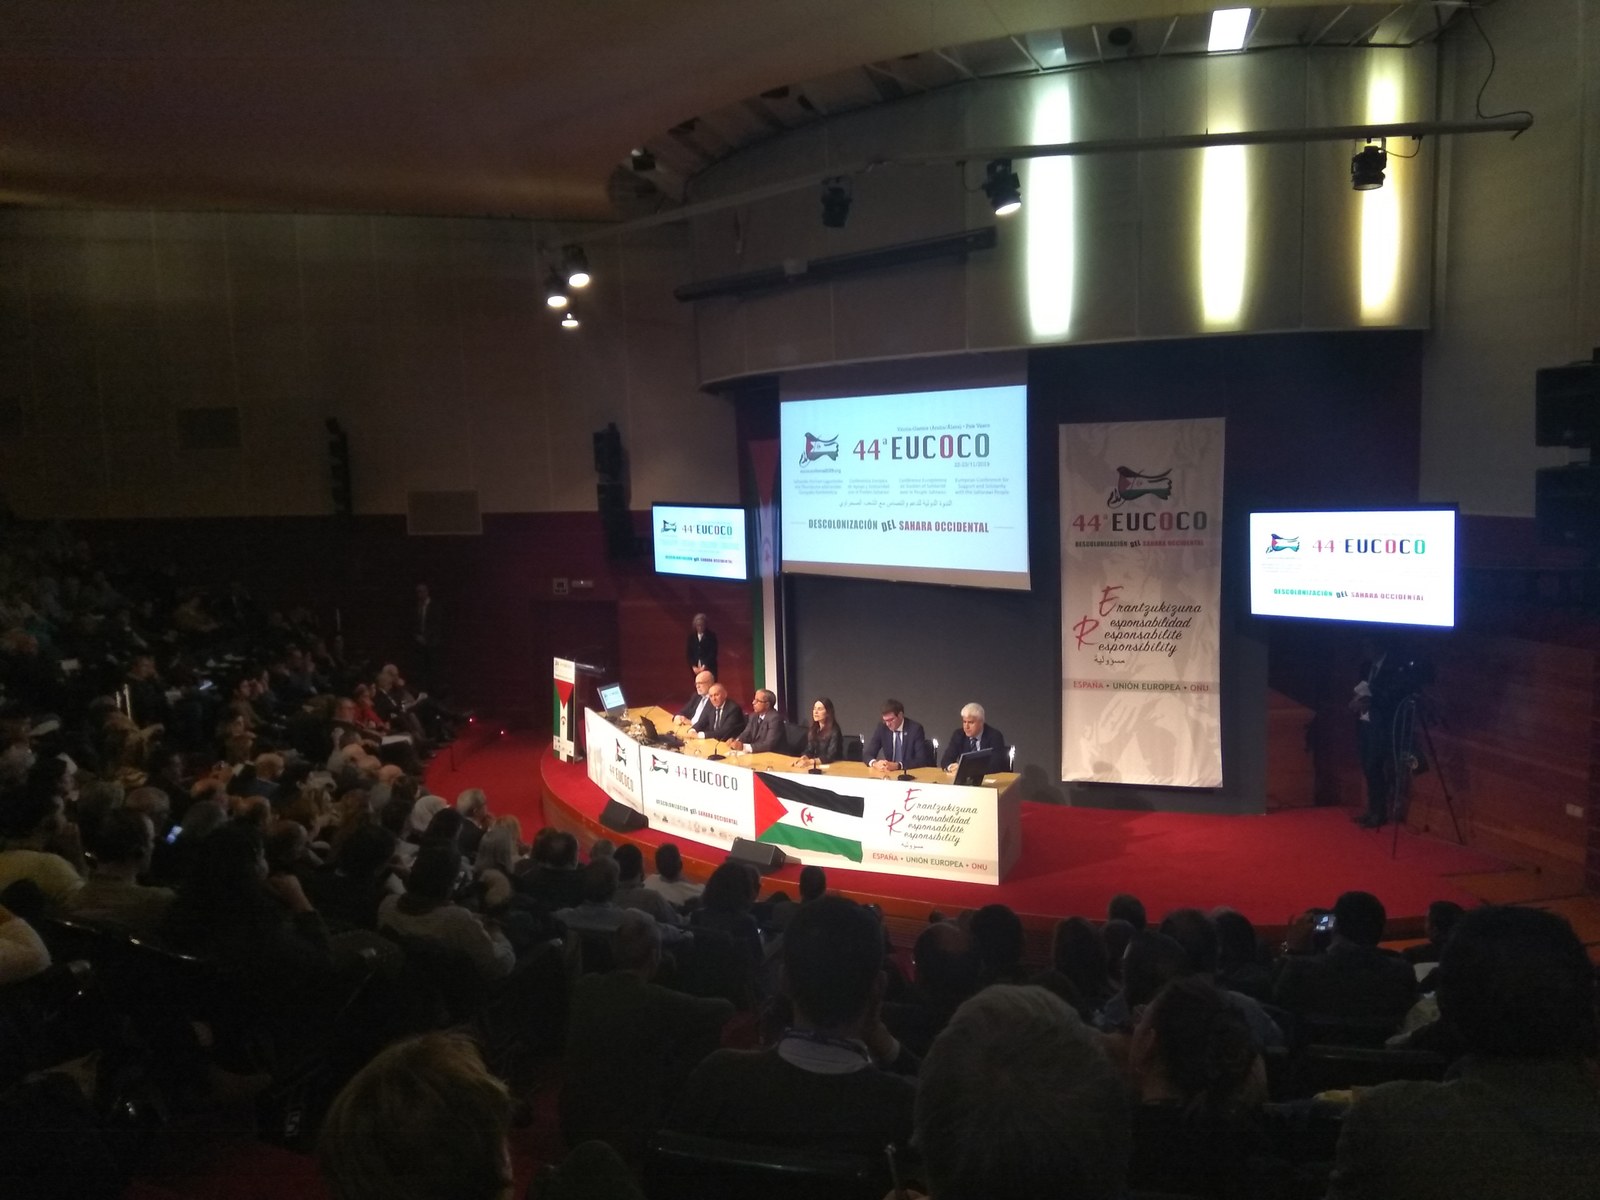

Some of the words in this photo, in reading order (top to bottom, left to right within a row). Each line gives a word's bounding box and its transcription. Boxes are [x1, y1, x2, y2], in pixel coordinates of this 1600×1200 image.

[891, 433, 990, 460] EUCOCO
[696, 524, 733, 536] EUCOCO
[808, 519, 878, 530] DESCOLONIZACIÓN
[881, 519, 897, 533] DEL
[899, 520, 933, 532] SAHARA
[935, 521, 989, 533] OCCIDENTAL
[1112, 511, 1207, 532] EUCOCO
[1345, 538, 1426, 555] EUCOCO
[1073, 681, 1104, 689] ESPAÑA
[1112, 681, 1140, 690] UNIÓN
[1141, 683, 1181, 691] EUROPEA
[1190, 684, 1209, 692] ONU
[692, 768, 738, 791] EUCOCO
[872, 852, 898, 861] ESPAÑA
[906, 856, 929, 865] UNIÓN
[930, 858, 964, 868] EUROPEA
[971, 862, 988, 871] ONU
